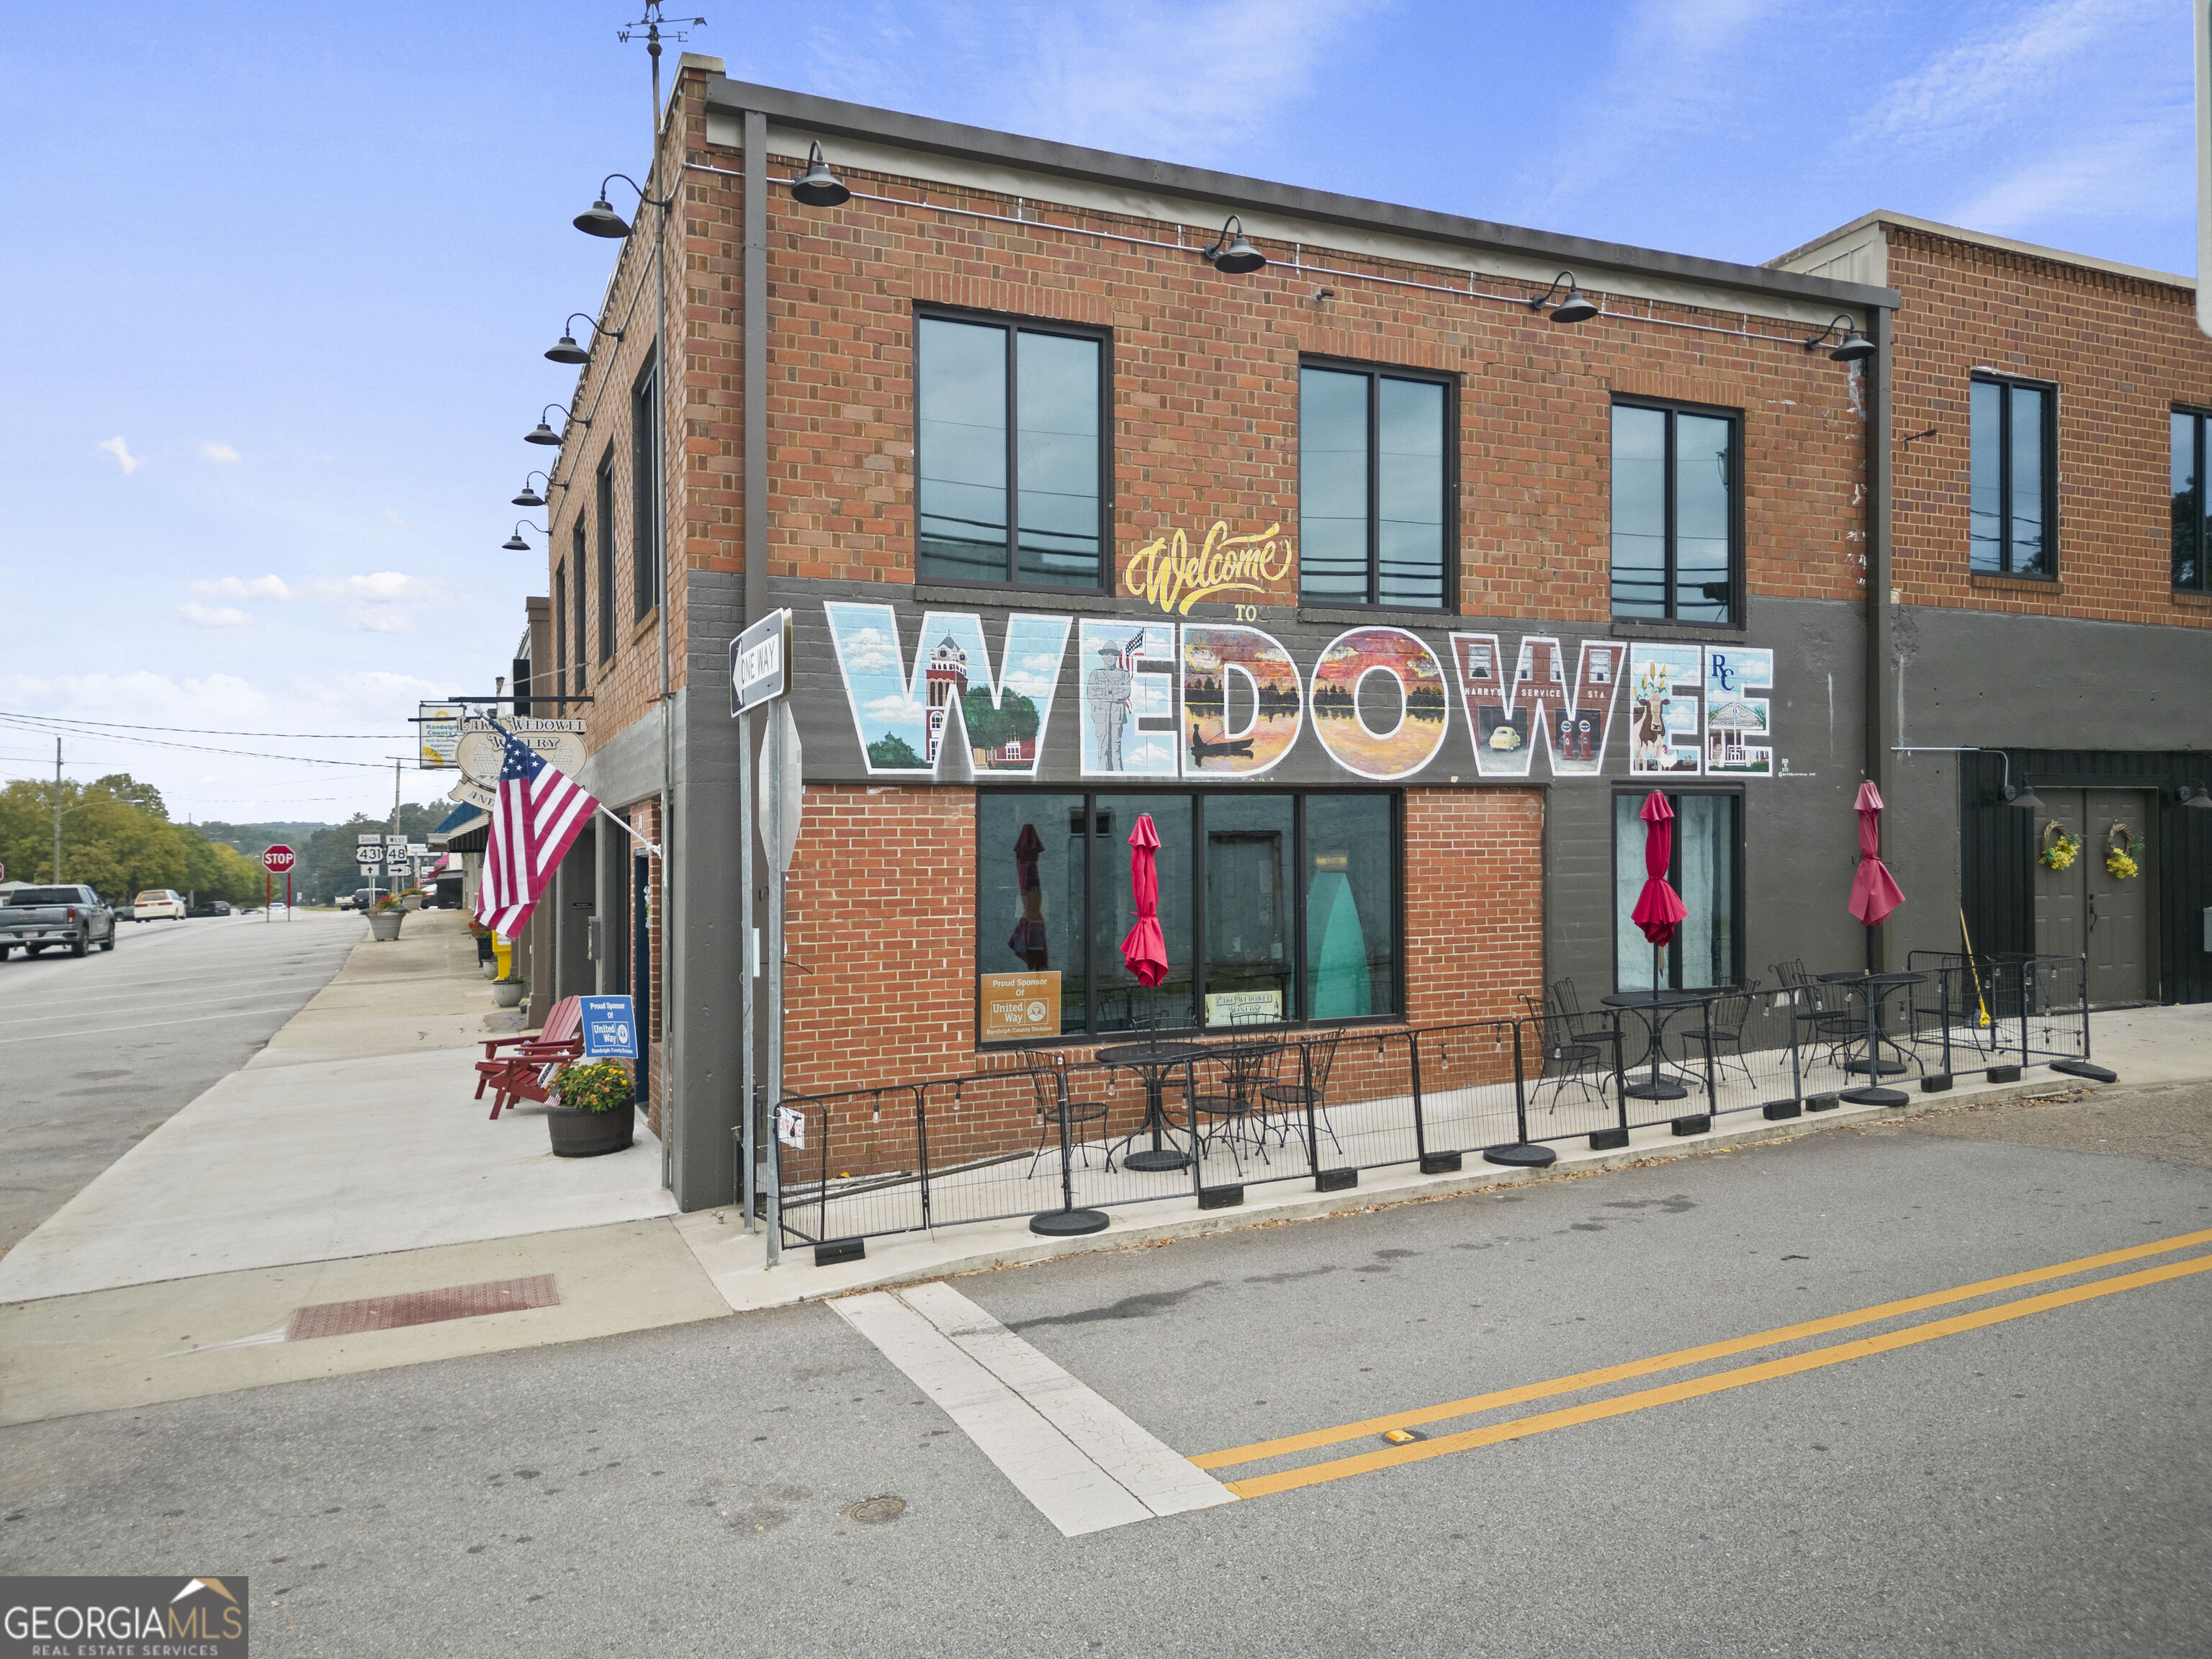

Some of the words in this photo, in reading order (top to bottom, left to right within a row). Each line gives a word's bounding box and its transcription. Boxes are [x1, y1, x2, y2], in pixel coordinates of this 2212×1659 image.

[1125, 520, 1292, 616] Welcome
[1234, 604, 1257, 622] TO
[742, 652, 755, 685] ONE
[757, 640, 775, 676] WAY
[823, 600, 1773, 781] WEDOWEE
[1465, 688, 1502, 696] HARRY'S
[1521, 688, 1560, 698] SERVICE
[1588, 691, 1606, 699] STA.
[508, 714, 586, 733] WEDOWEE
[487, 735, 557, 750] WERY
[264, 853, 294, 865] STOP
[359, 849, 382, 859] 431
[388, 848, 405, 859] 48
[1017, 979, 1048, 987] Sponsor
[993, 1002, 1023, 1013] United
[1004, 1013, 1022, 1024] Way
[593, 1025, 616, 1034] United
[603, 1034, 616, 1044] Way
